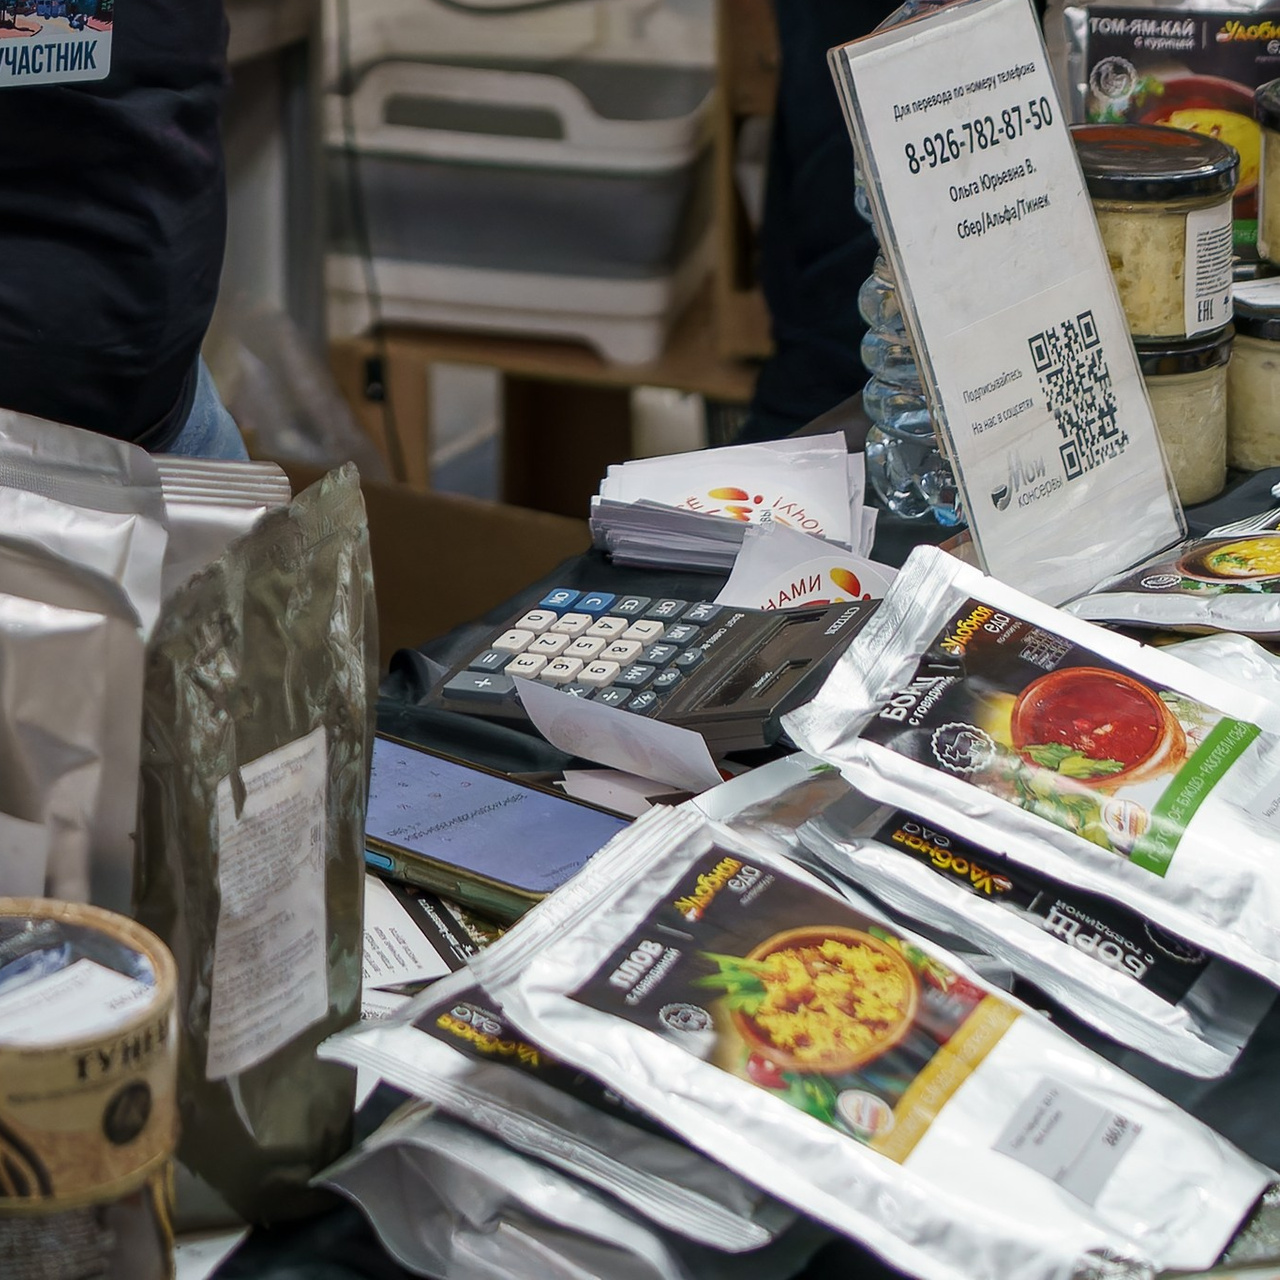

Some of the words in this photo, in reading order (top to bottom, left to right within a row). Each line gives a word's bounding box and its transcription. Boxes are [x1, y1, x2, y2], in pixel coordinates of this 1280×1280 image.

[1089, 17, 1195, 37] ТОМ-ЯМ-КАЙ
[893, 104, 912, 122] Для
[911, 89, 953, 113] перевода
[953, 85, 965, 99] по
[965, 76, 997, 97] номеру
[997, 61, 1036, 83] телефона
[904, 96, 1053, 175] 8-926-782-87-50
[949, 179, 980, 203] Ольга
[979, 163, 1026, 193] Юрьевна
[1025, 158, 1037, 175] В.
[962, 368, 1023, 404] Подписывайтесь
[971, 421, 984, 436] На
[984, 414, 998, 431] нас
[1004, 397, 1035, 422] соцсетях
[1018, 475, 1063, 509] консервы
[824, 605, 860, 636] CITIZEN
[940, 605, 995, 650] Удобная
[984, 613, 1010, 634] еда
[908, 717, 921, 727] с
[1180, 775, 1206, 807] БЛЮДО
[902, 821, 951, 848] еда
[727, 864, 763, 893] еда
[891, 829, 994, 894] Удобная
[674, 856, 744, 910] Удобная
[1043, 905, 1148, 981] БОРЩ
[1056, 898, 1143, 956] говядиной
[609, 940, 664, 990] ПЛОВ
[634, 946, 682, 1000] говядиной
[1144, 952, 1155, 964] с
[450, 1006, 502, 1035] еда
